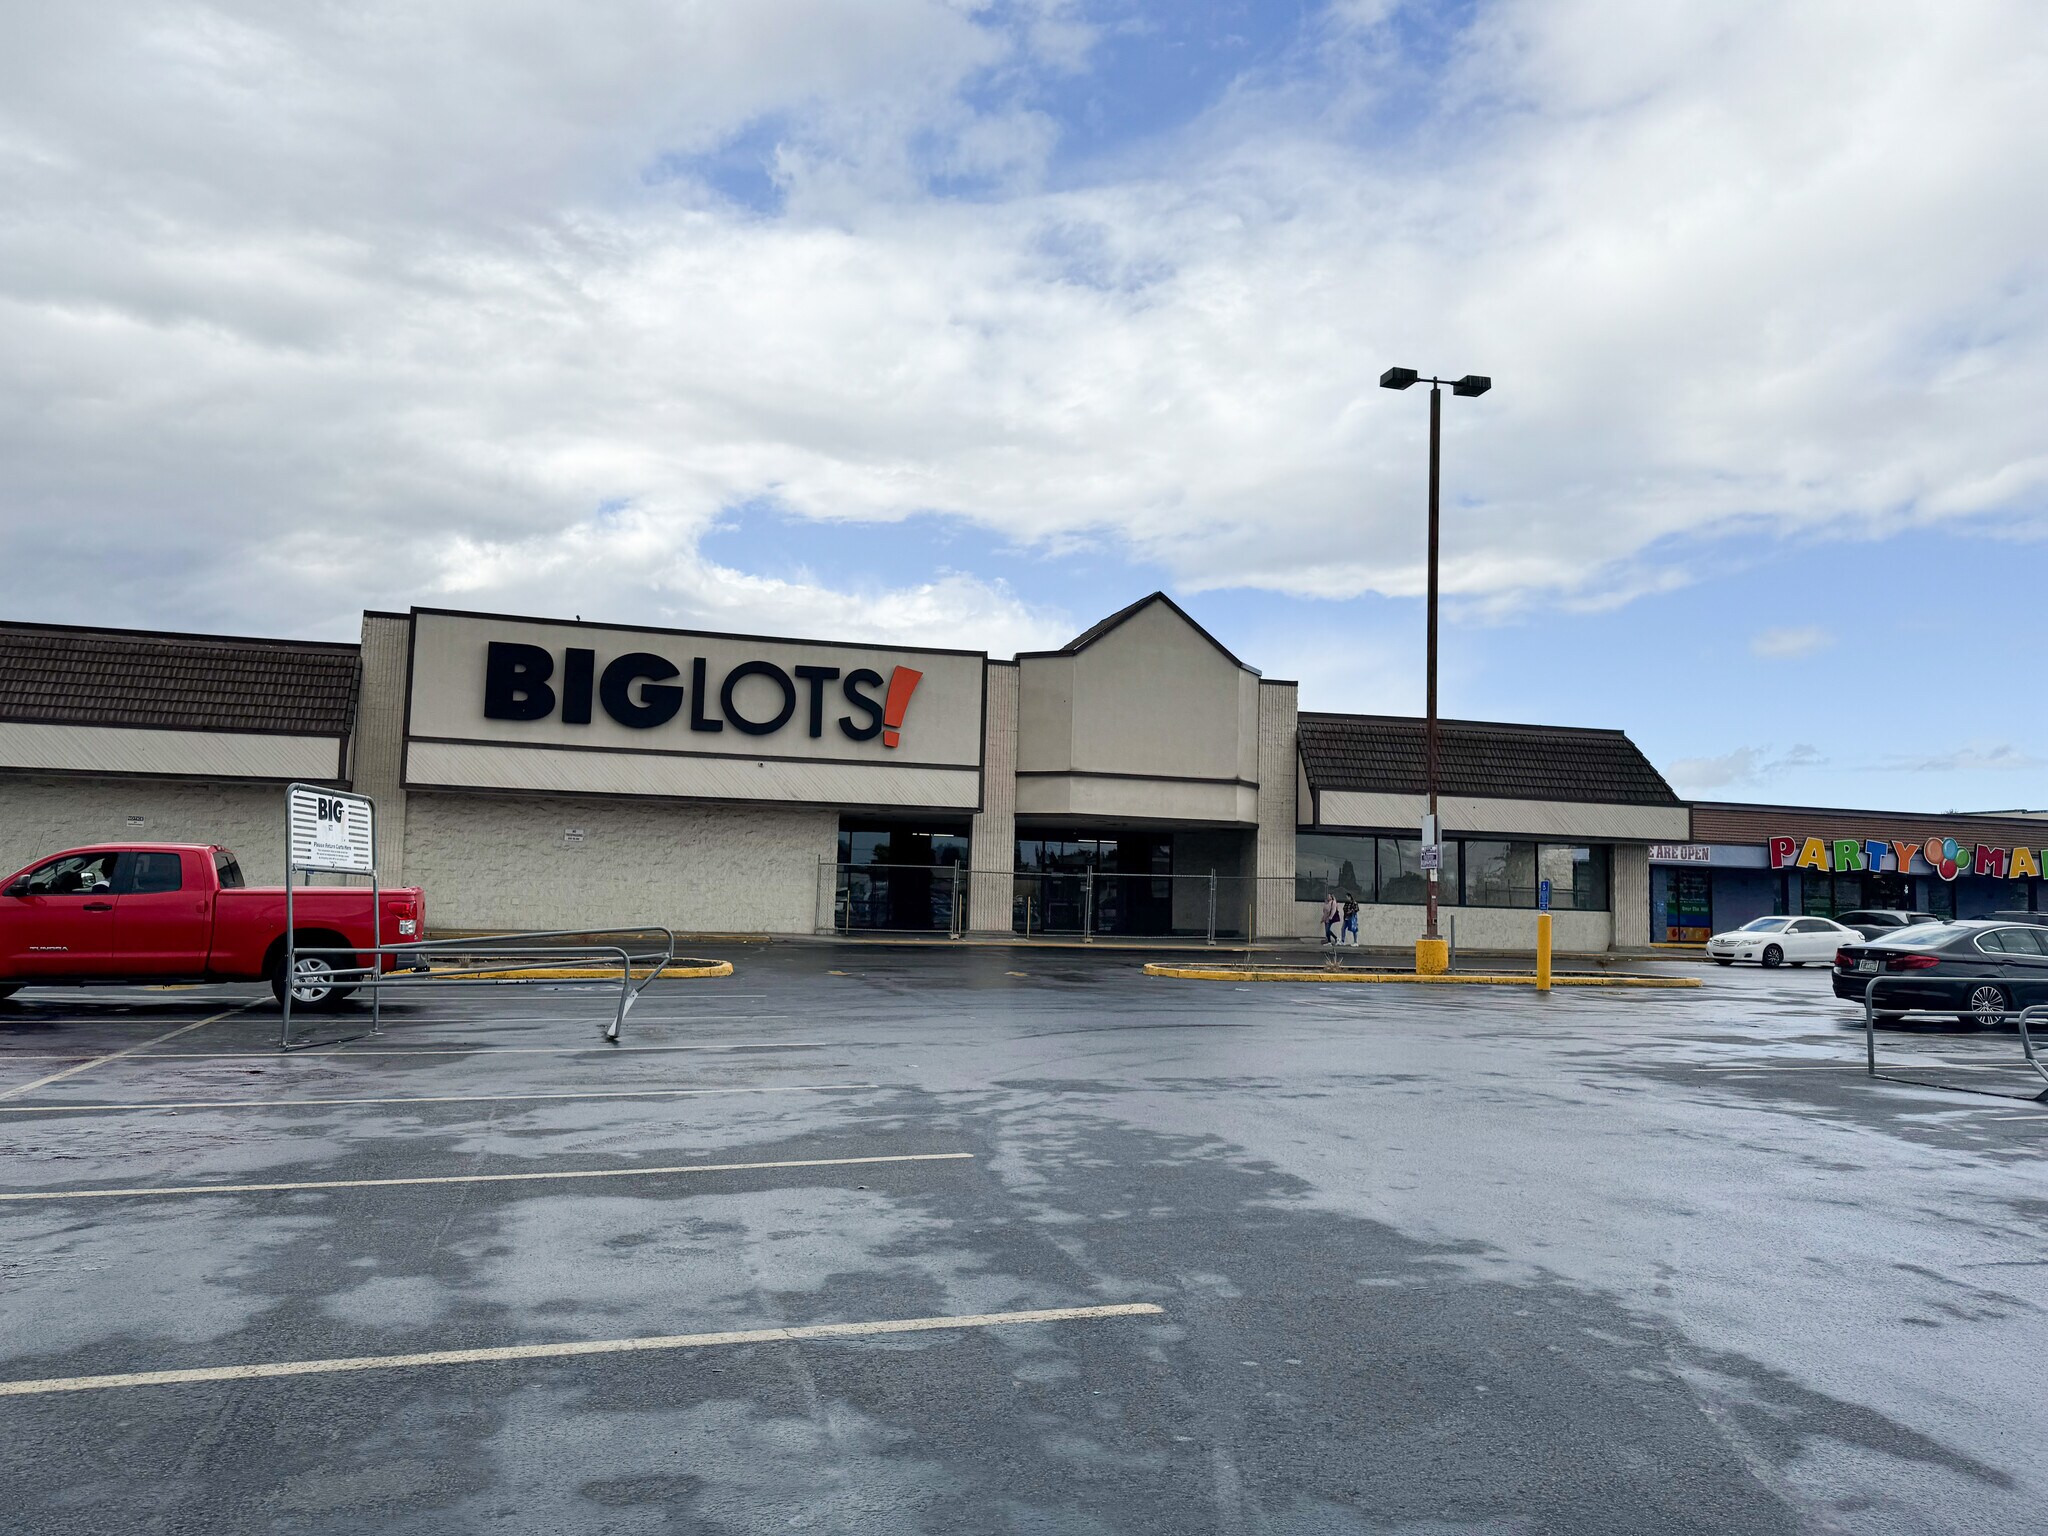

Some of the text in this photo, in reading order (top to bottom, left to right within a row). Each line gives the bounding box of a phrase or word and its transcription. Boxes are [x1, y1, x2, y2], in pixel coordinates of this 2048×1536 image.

[318, 797, 345, 823] BIG
[1656, 845, 1678, 859] ARE
[1681, 846, 1709, 860] OPEN
[1768, 836, 2048, 880] PARTY MA
